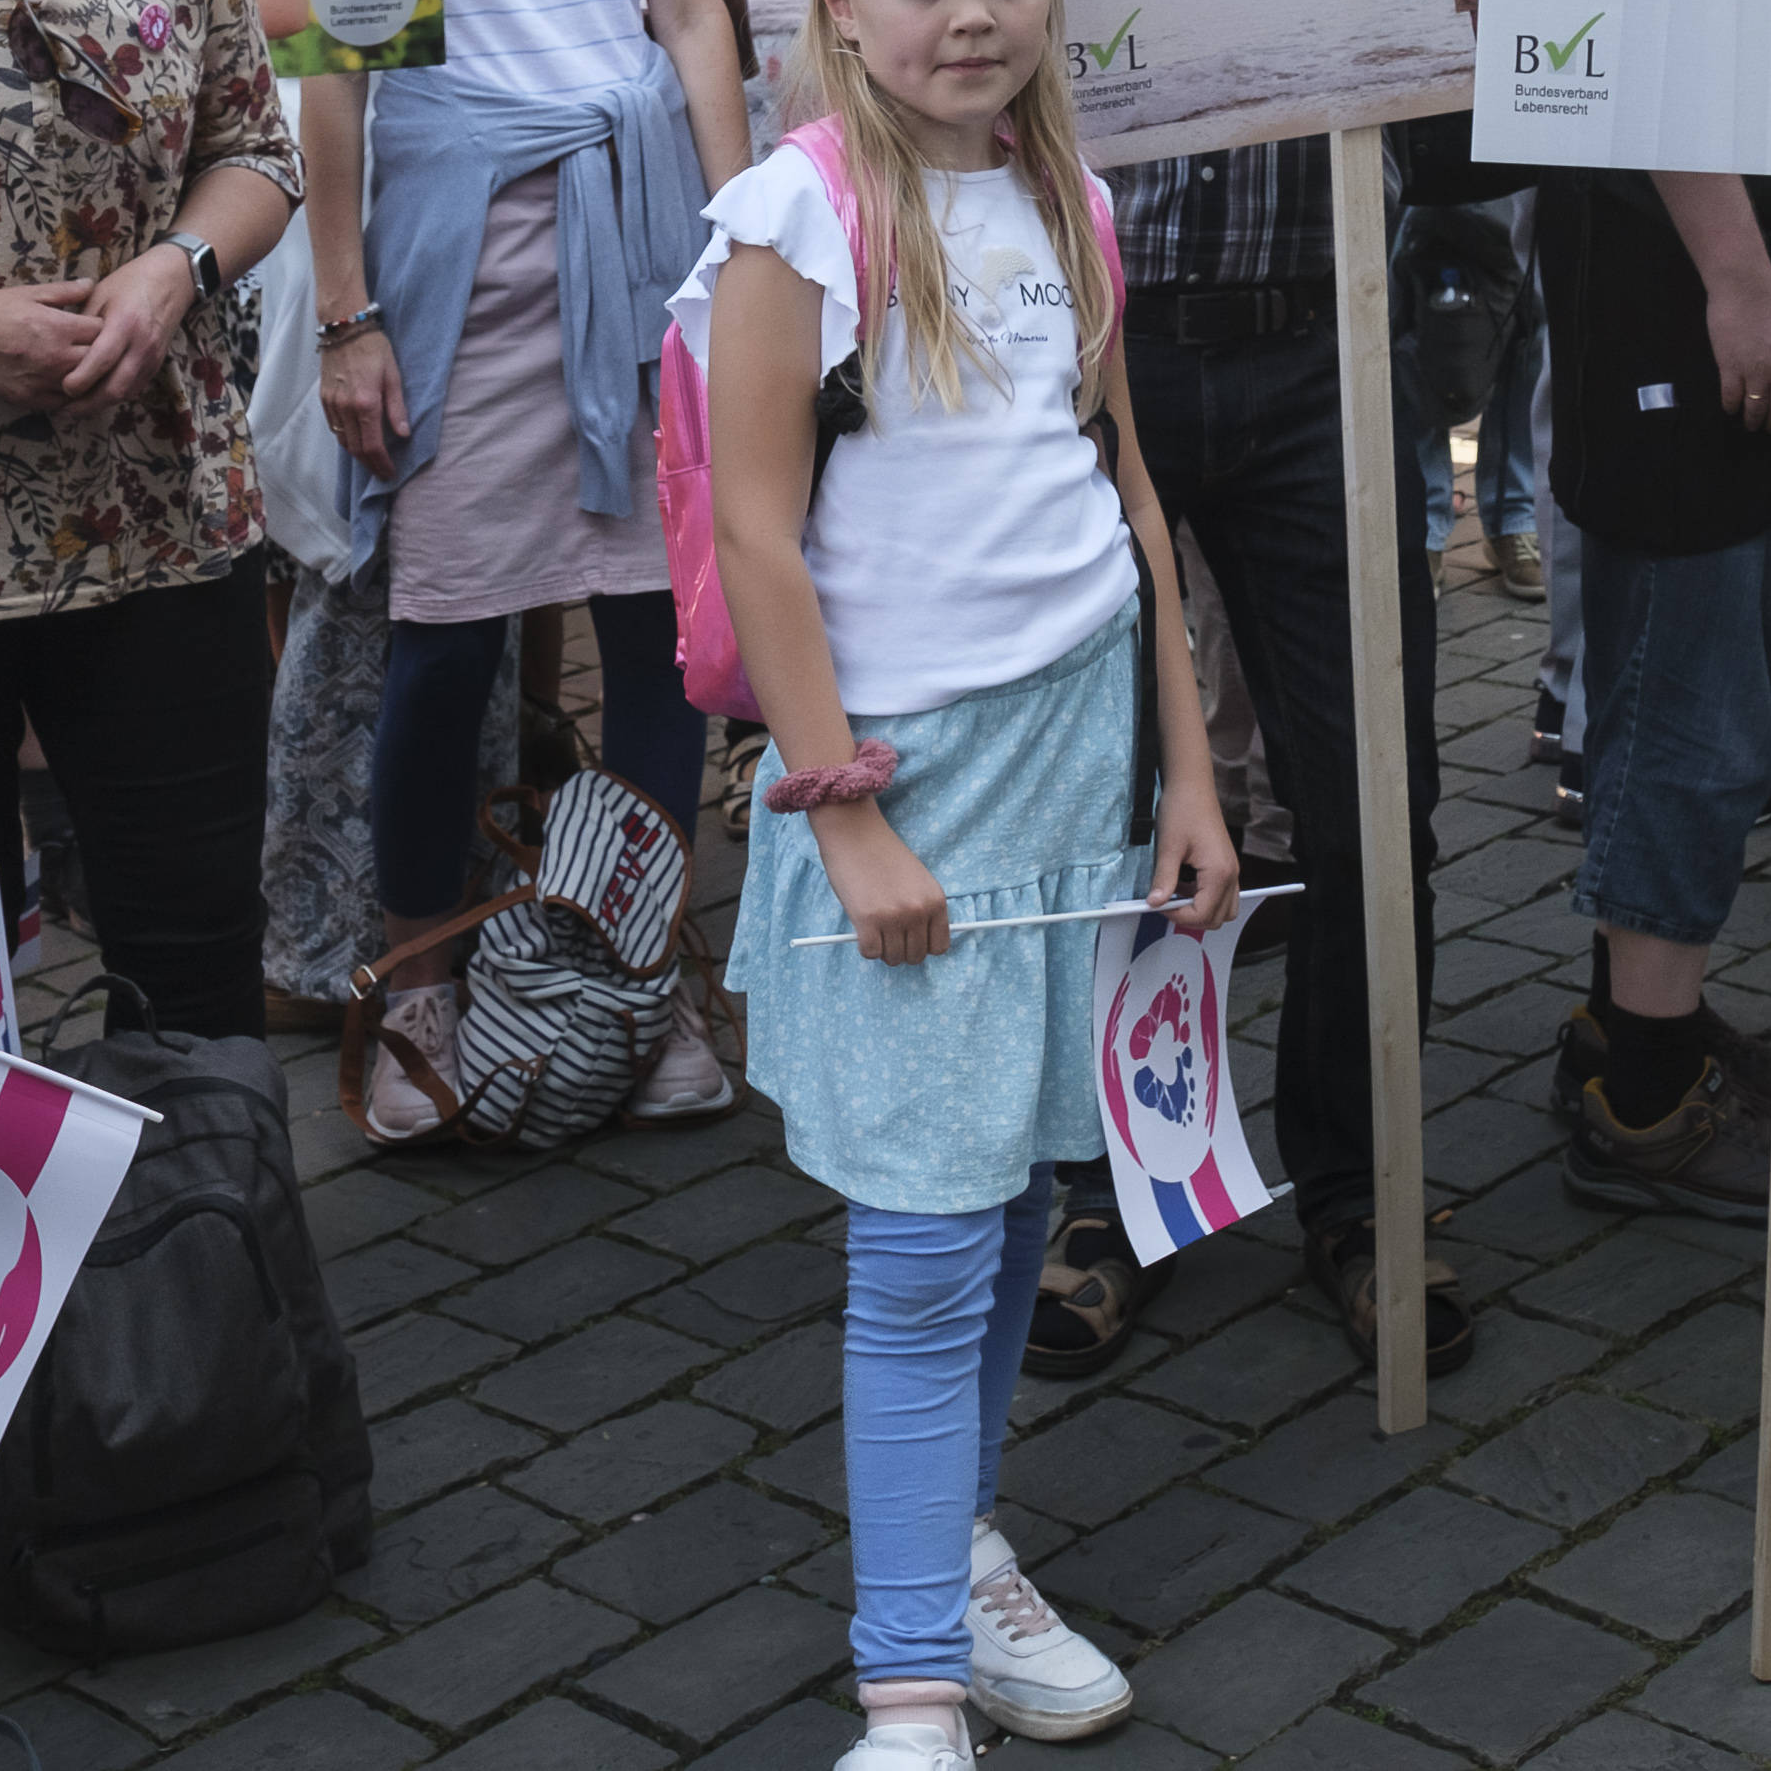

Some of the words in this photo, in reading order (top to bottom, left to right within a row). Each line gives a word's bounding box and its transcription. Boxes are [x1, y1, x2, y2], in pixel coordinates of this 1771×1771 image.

[1072, 78, 1153, 100] undesverband
[1515, 83, 1609, 101] Bundesverband
[1514, 99, 1589, 116] Lebensrecht
